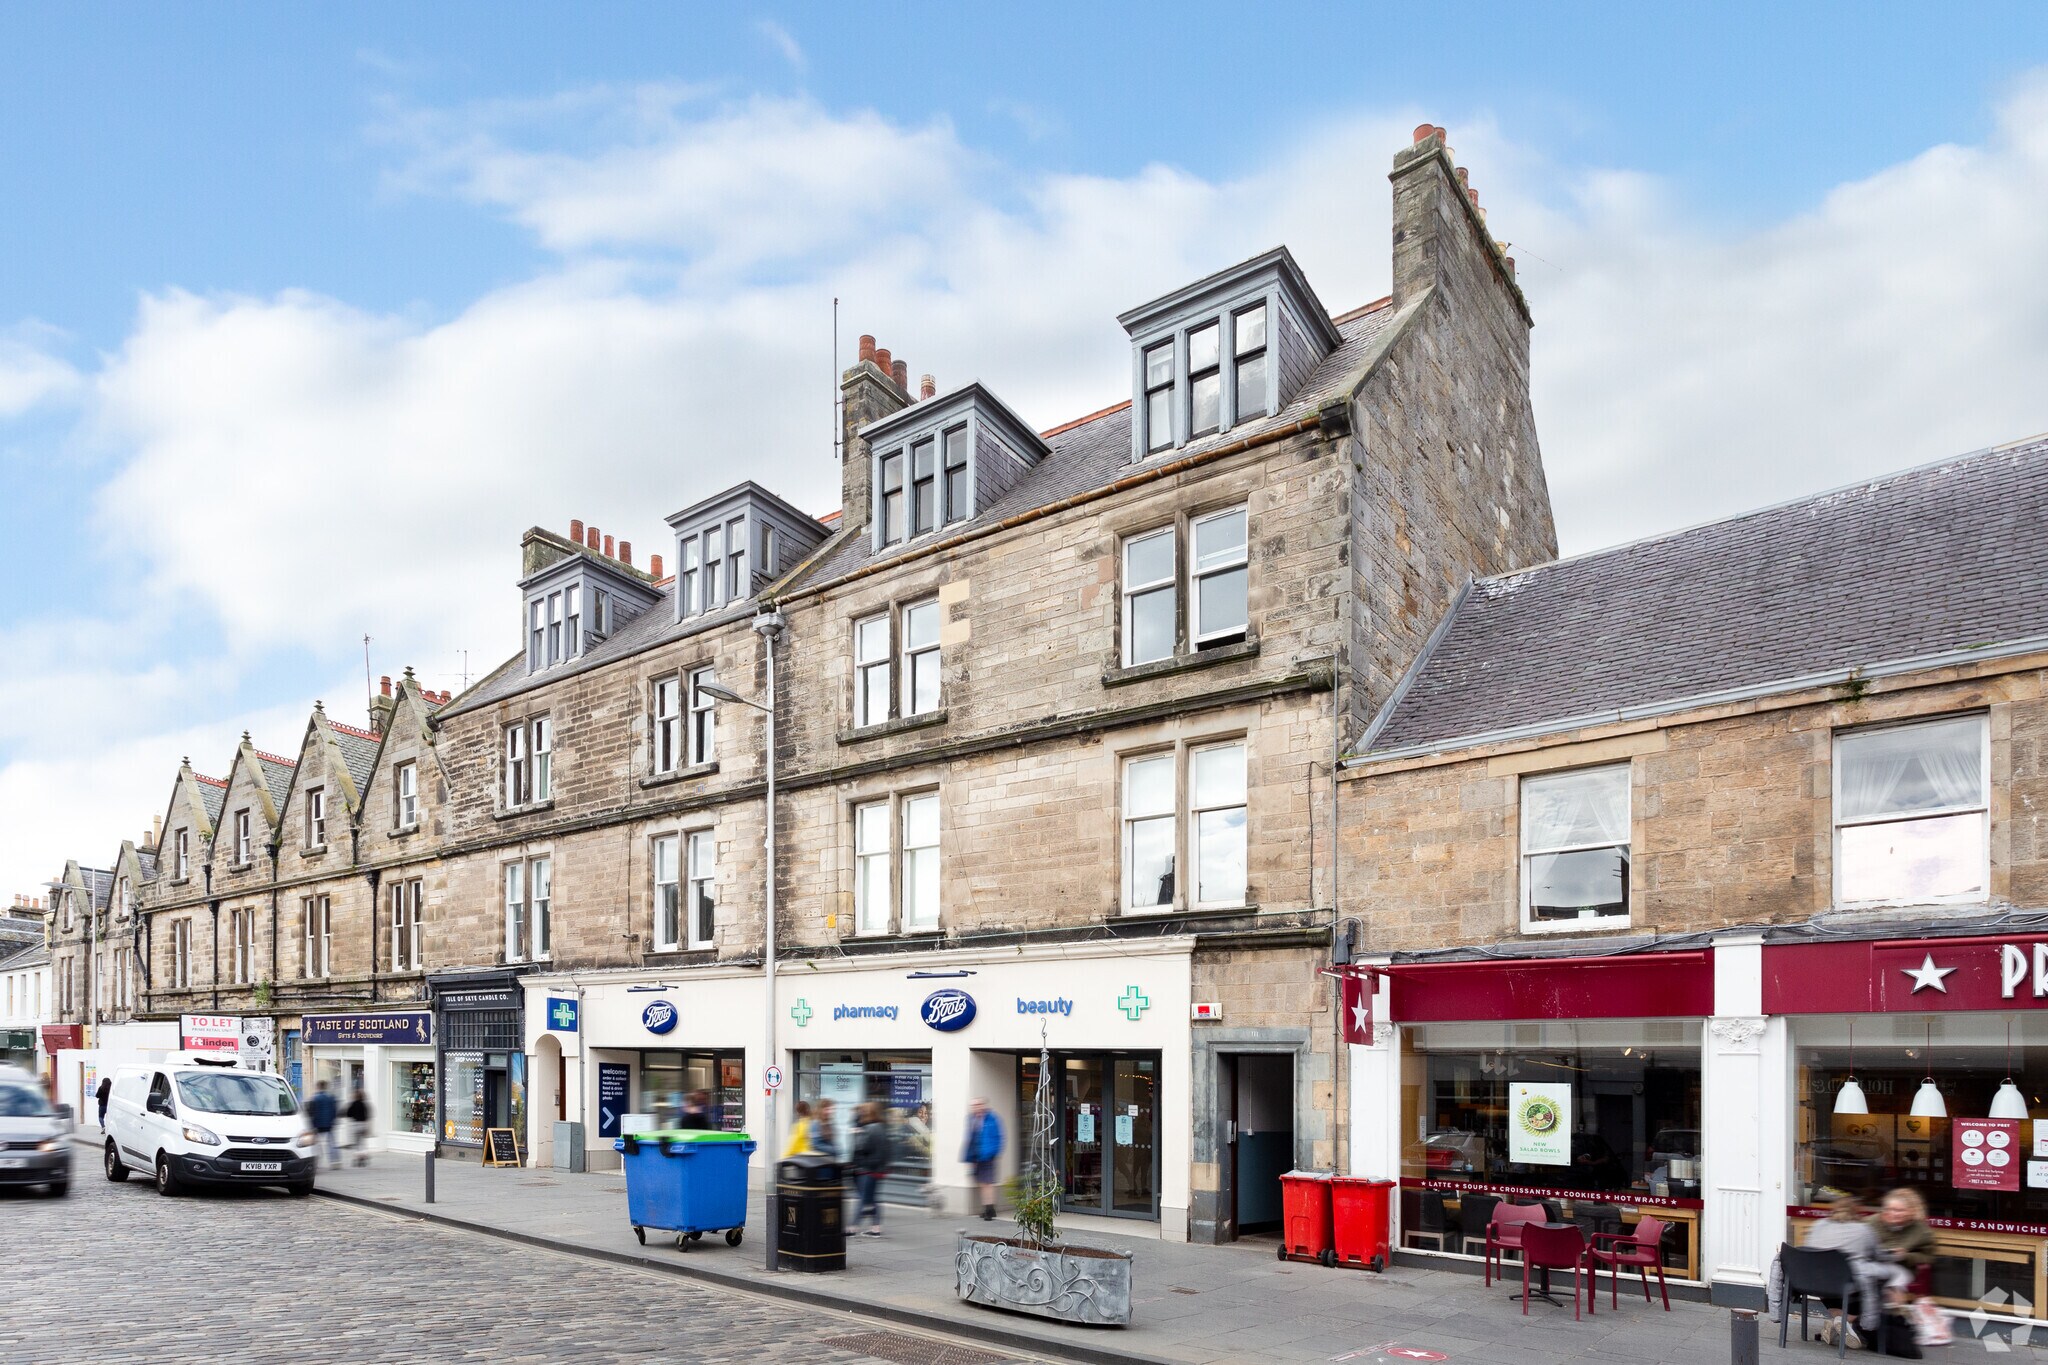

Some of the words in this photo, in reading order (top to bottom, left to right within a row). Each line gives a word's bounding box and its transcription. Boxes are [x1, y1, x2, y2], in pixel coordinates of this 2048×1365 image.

[833, 1003, 899, 1021] pharmacy
[926, 996, 967, 1024] Boots
[1017, 997, 1073, 1016] beauty
[191, 1017, 208, 1027] TO
[212, 1018, 232, 1028] LET
[316, 1020, 341, 1030] TASTE
[344, 1020, 356, 1030] OF
[359, 1018, 410, 1030] SCOTLAND
[645, 1006, 671, 1028] Boots
[1500, 1186, 1551, 1196] CROISSANTS
[1564, 1191, 1600, 1199] COOKIES
[1634, 1196, 1666, 1204] WRAPS
